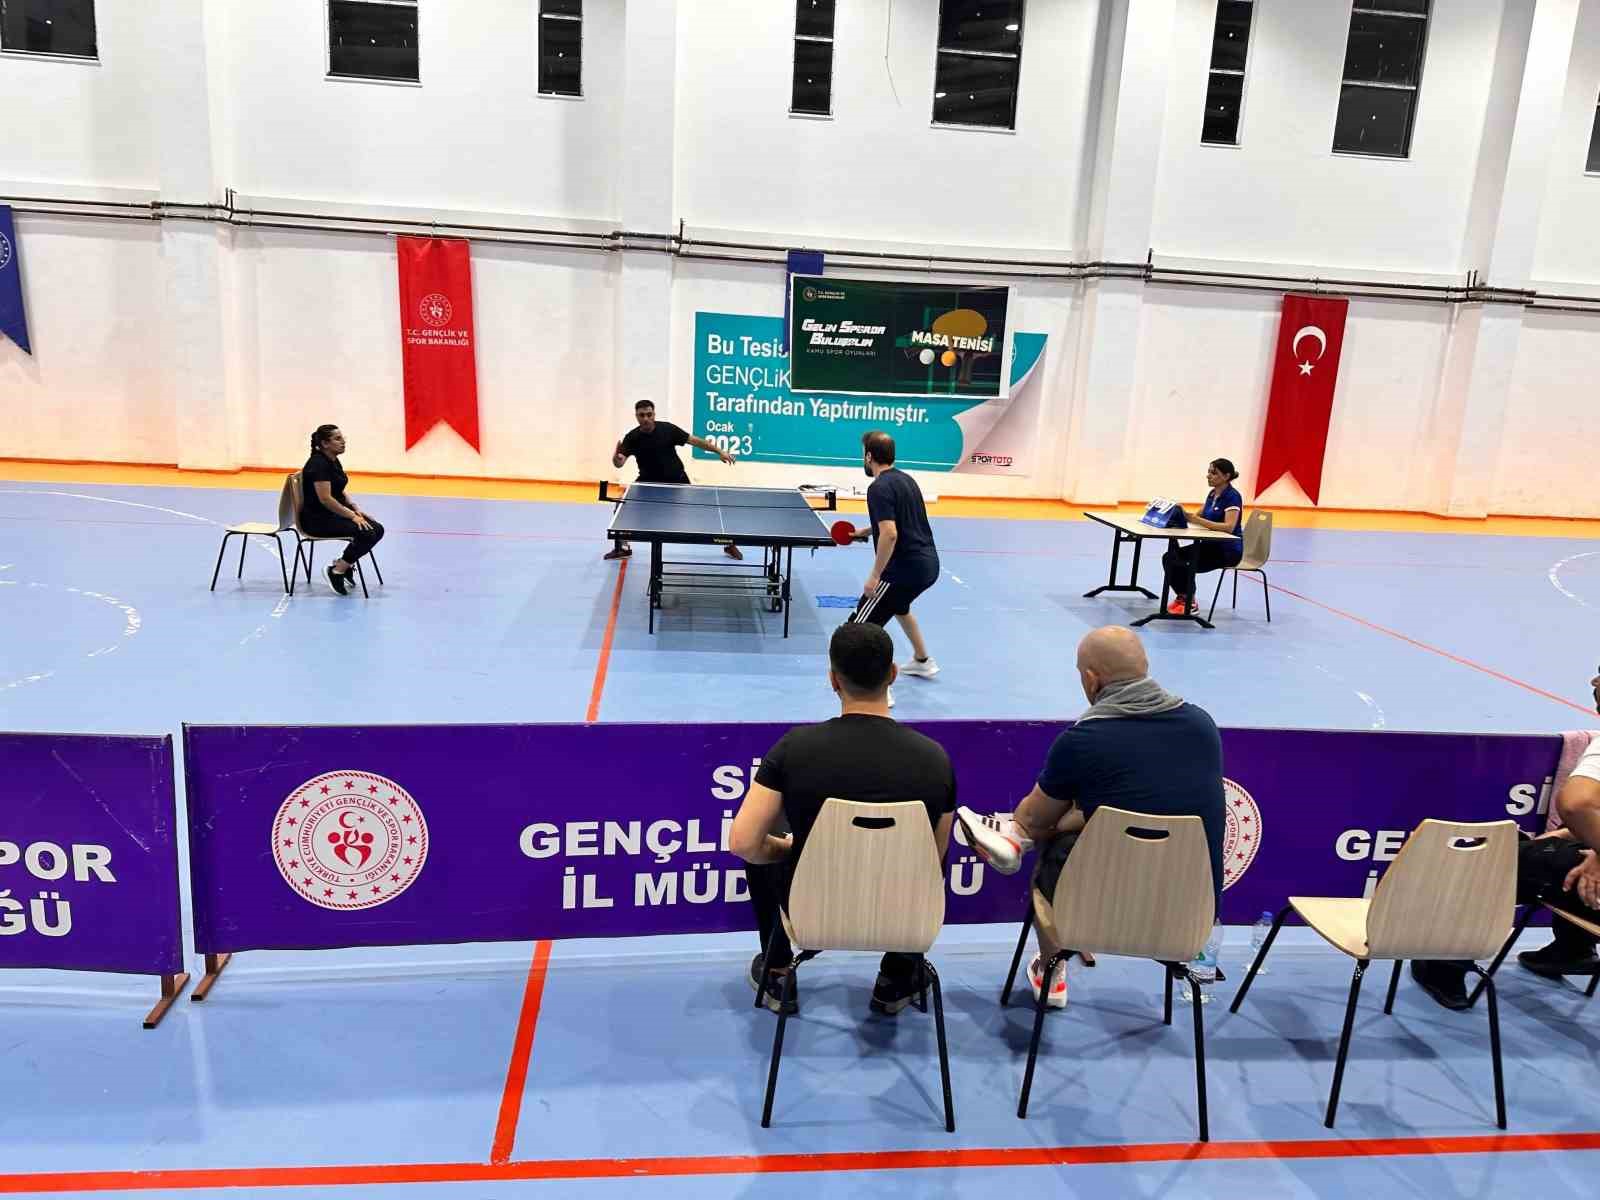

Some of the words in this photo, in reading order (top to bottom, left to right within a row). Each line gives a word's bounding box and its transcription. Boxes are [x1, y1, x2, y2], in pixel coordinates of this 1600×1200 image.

[707, 333, 735, 355] Bu
[911, 330, 950, 347] MASA
[705, 391, 805, 417] Tarafından
[706, 419, 735, 433] Ocak
[385, 817, 399, 842] SPOR
[1335, 829, 1407, 861] GE
[562, 866, 614, 909] İL
